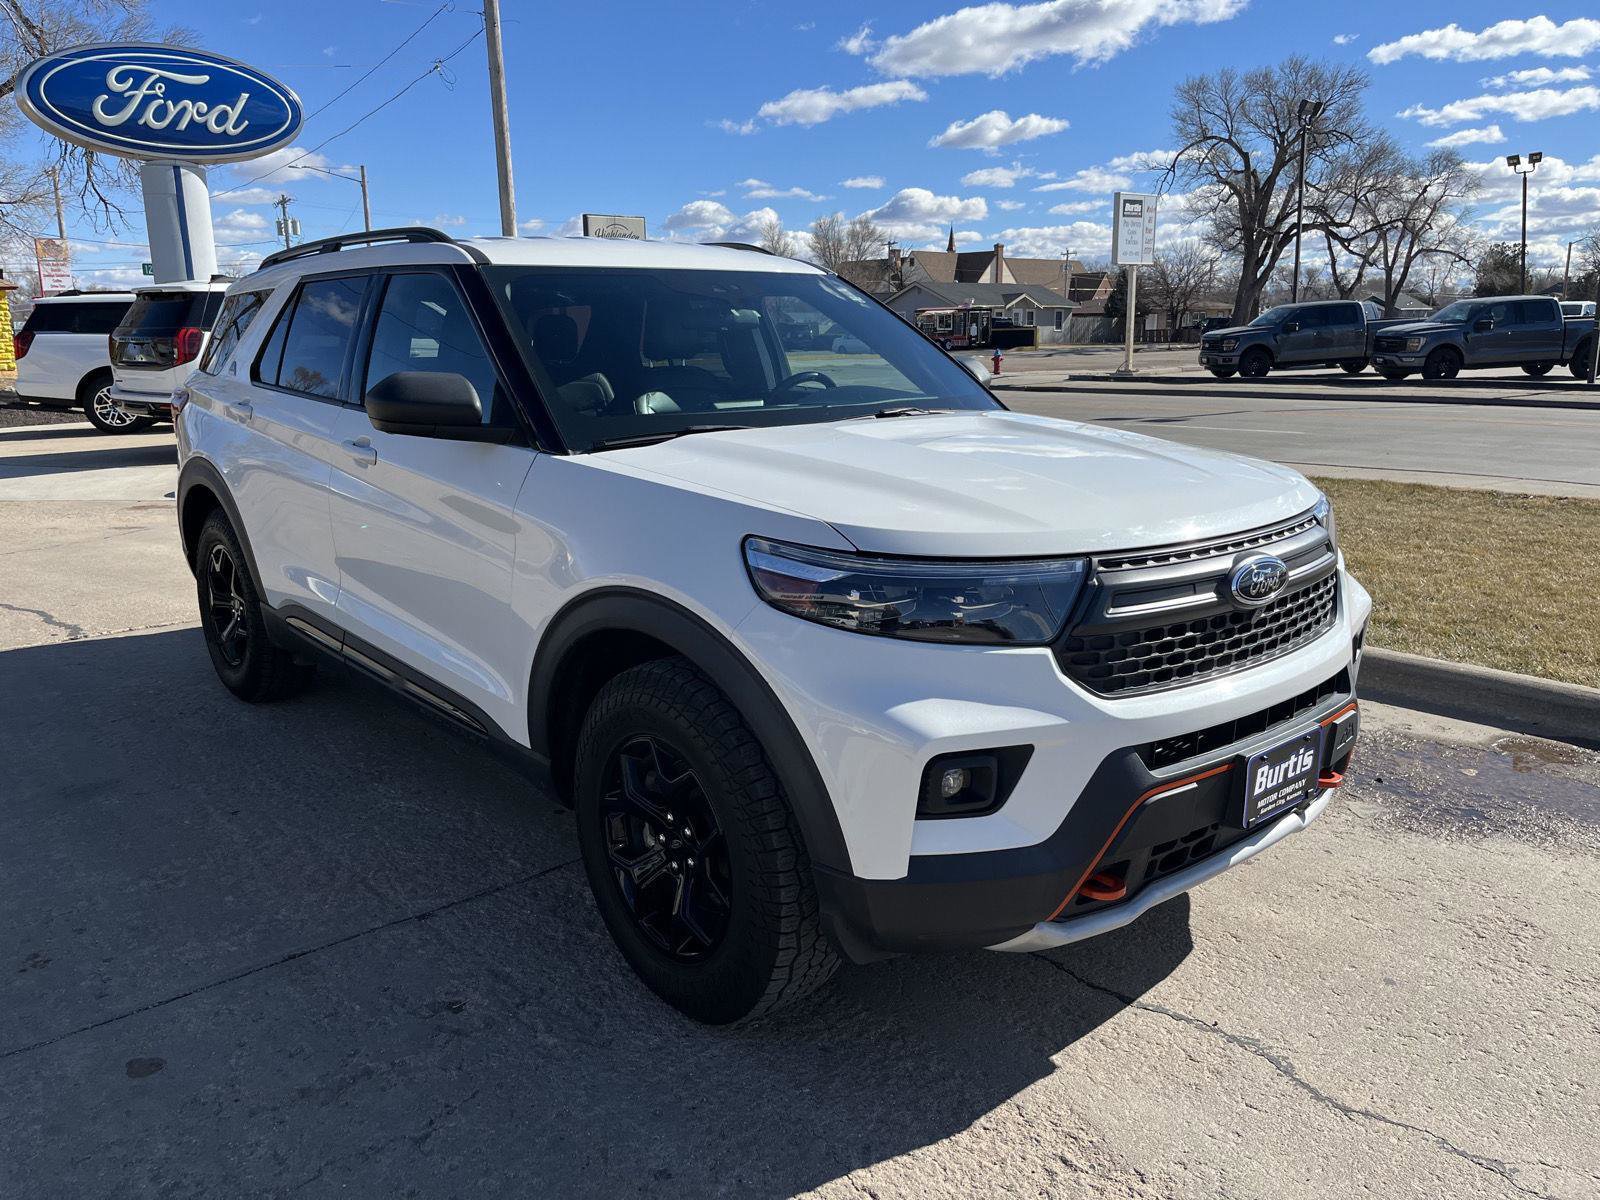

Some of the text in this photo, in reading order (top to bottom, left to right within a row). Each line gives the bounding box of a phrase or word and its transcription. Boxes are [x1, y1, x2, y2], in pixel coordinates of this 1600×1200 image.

[92, 64, 250, 136] Ford
[1250, 567, 1281, 596] Ford
[1253, 747, 1314, 796] Burtis
[1257, 778, 1307, 809] MOTOR COMPANY
